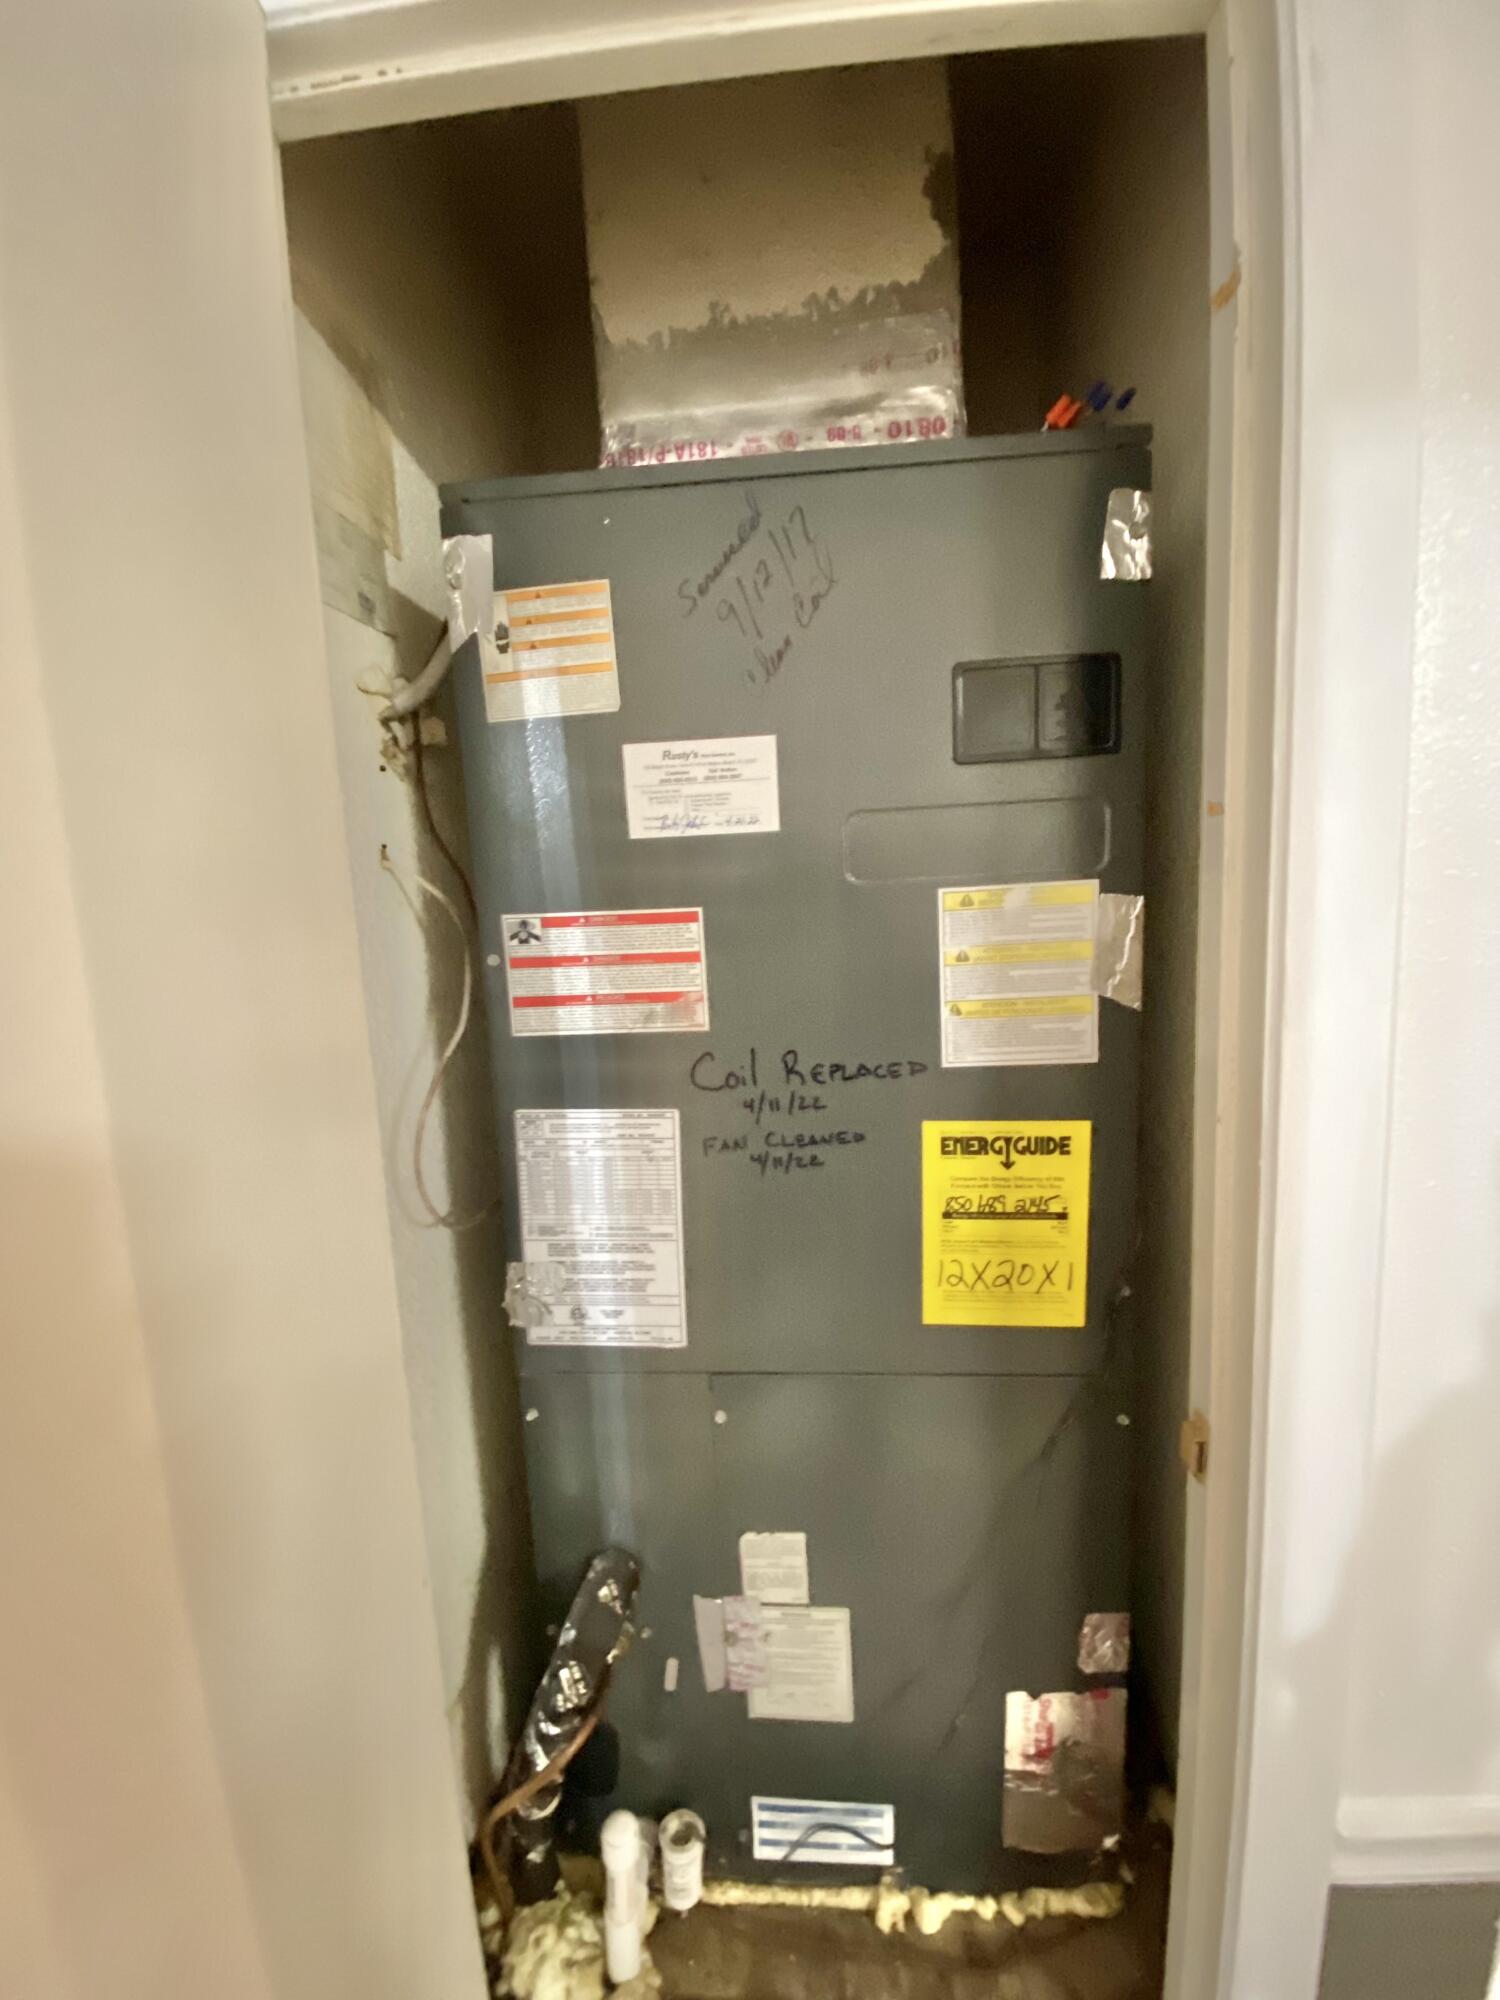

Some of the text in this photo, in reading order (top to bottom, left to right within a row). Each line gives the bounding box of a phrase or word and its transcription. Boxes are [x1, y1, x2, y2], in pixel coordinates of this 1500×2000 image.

[716, 505, 816, 640] 9/12/17
[662, 750, 699, 761] Rusty's
[690, 1048, 928, 1091] Coil REPLACED
[743, 1090, 827, 1125] 4/11/22
[703, 1131, 866, 1156] FAN CLEANED
[752, 1152, 825, 1176] 4/11/22
